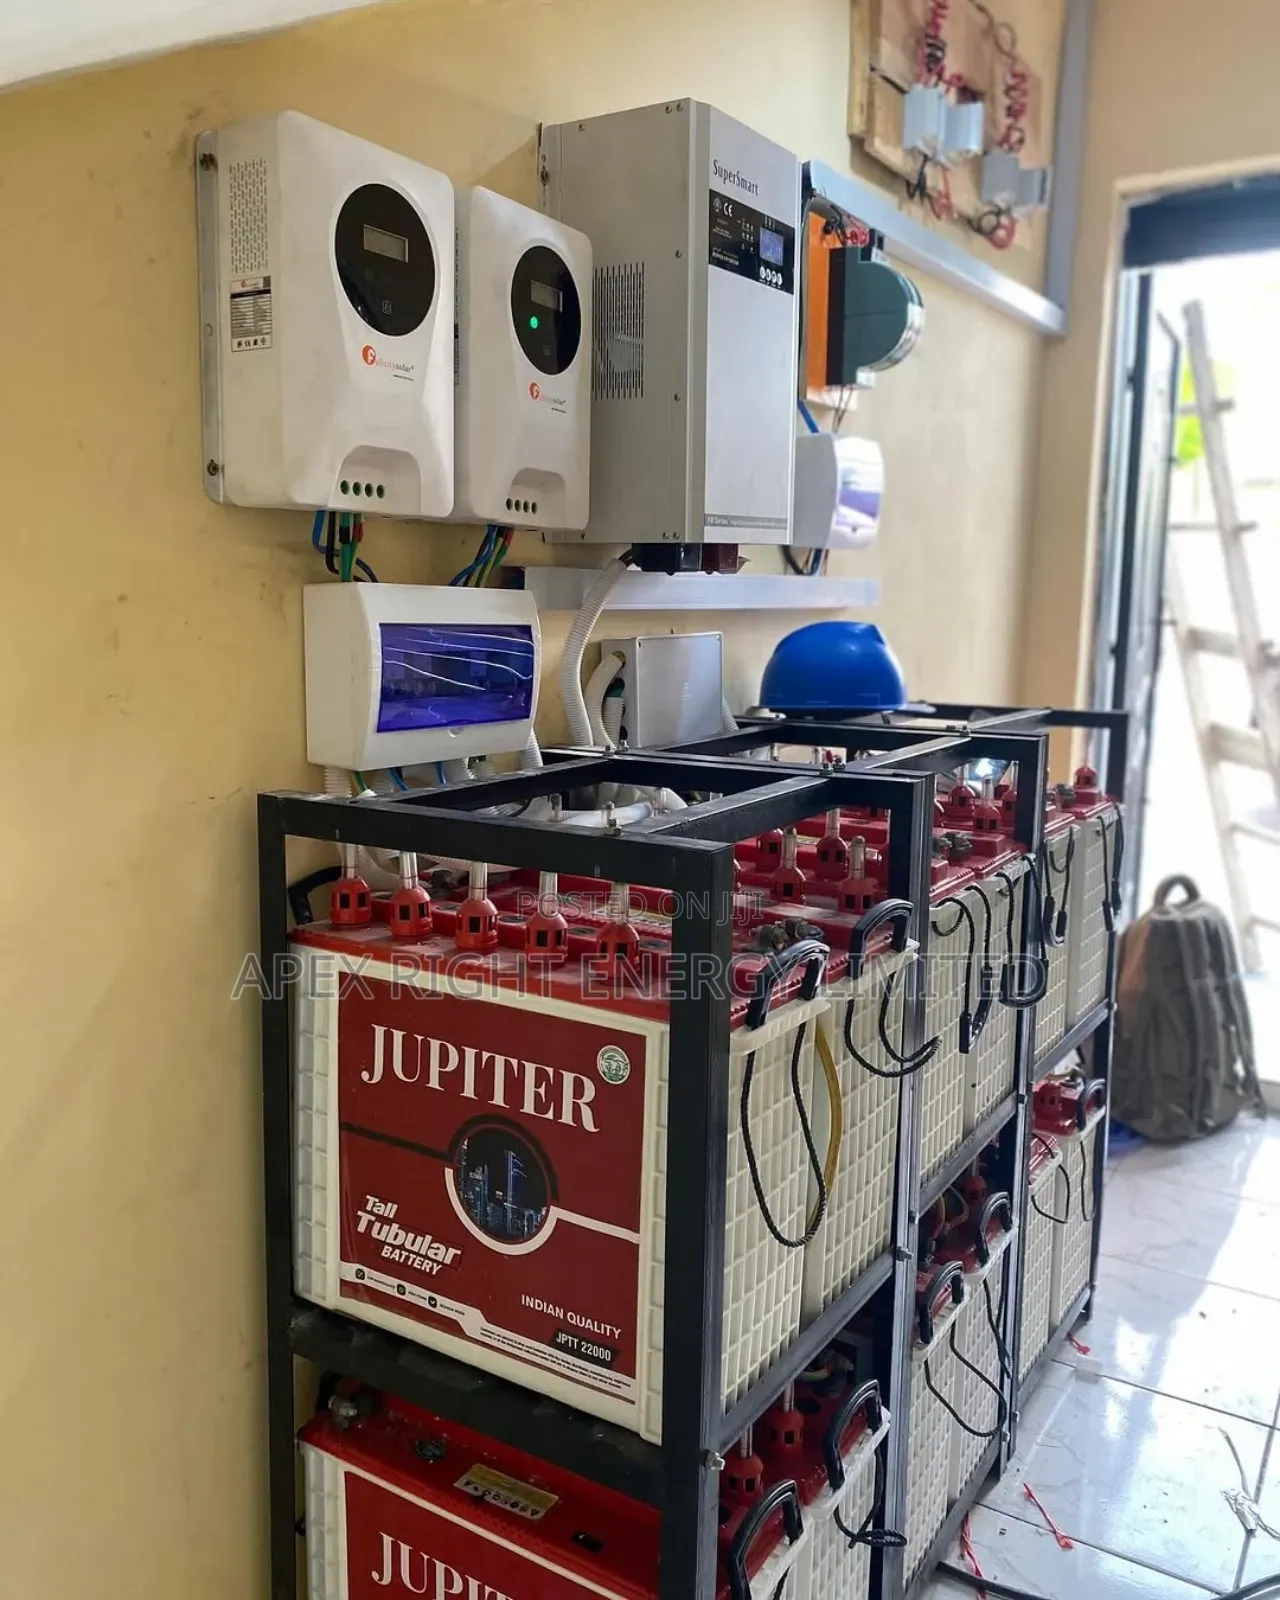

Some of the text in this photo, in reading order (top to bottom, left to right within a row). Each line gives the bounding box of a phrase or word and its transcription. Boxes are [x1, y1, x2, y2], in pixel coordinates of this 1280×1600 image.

[712, 159, 759, 196] SuperSmart
[361, 1023, 600, 1133] JUPITER
[365, 1194, 398, 1219] Tall
[357, 1210, 462, 1265] Tubular
[381, 1245, 443, 1276] BATTERY
[521, 1294, 622, 1340] INDIAN QUALITY
[556, 1331, 612, 1362] JPTT 22000
